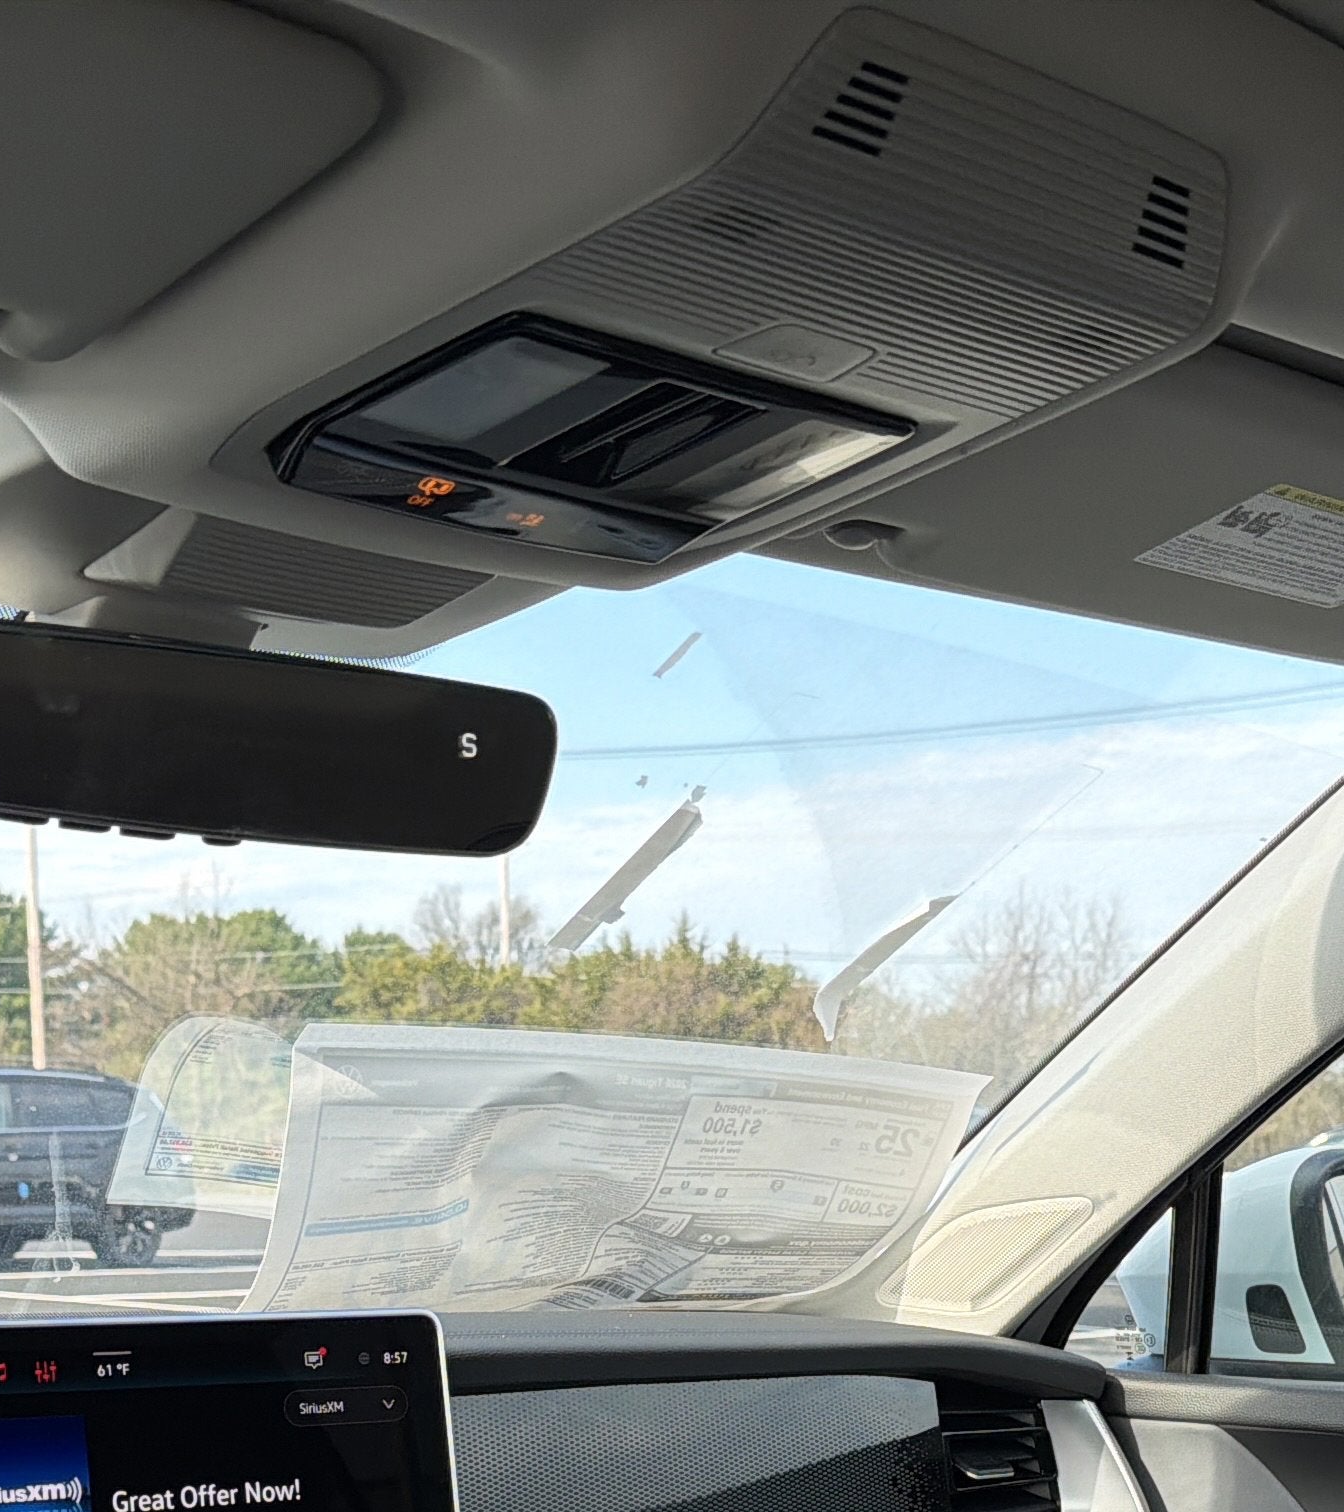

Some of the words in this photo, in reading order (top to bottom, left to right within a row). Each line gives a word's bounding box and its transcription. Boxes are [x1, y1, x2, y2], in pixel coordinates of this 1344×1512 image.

[460, 732, 478, 758] S
[383, 1350, 408, 1364] 8:57
[97, 1364, 113, 1378] 61
[116, 1363, 131, 1377] °F
[298, 1401, 345, 1415] SiriusXM
[180, 1483, 239, 1509] Offer
[244, 1478, 302, 1504] Now!
